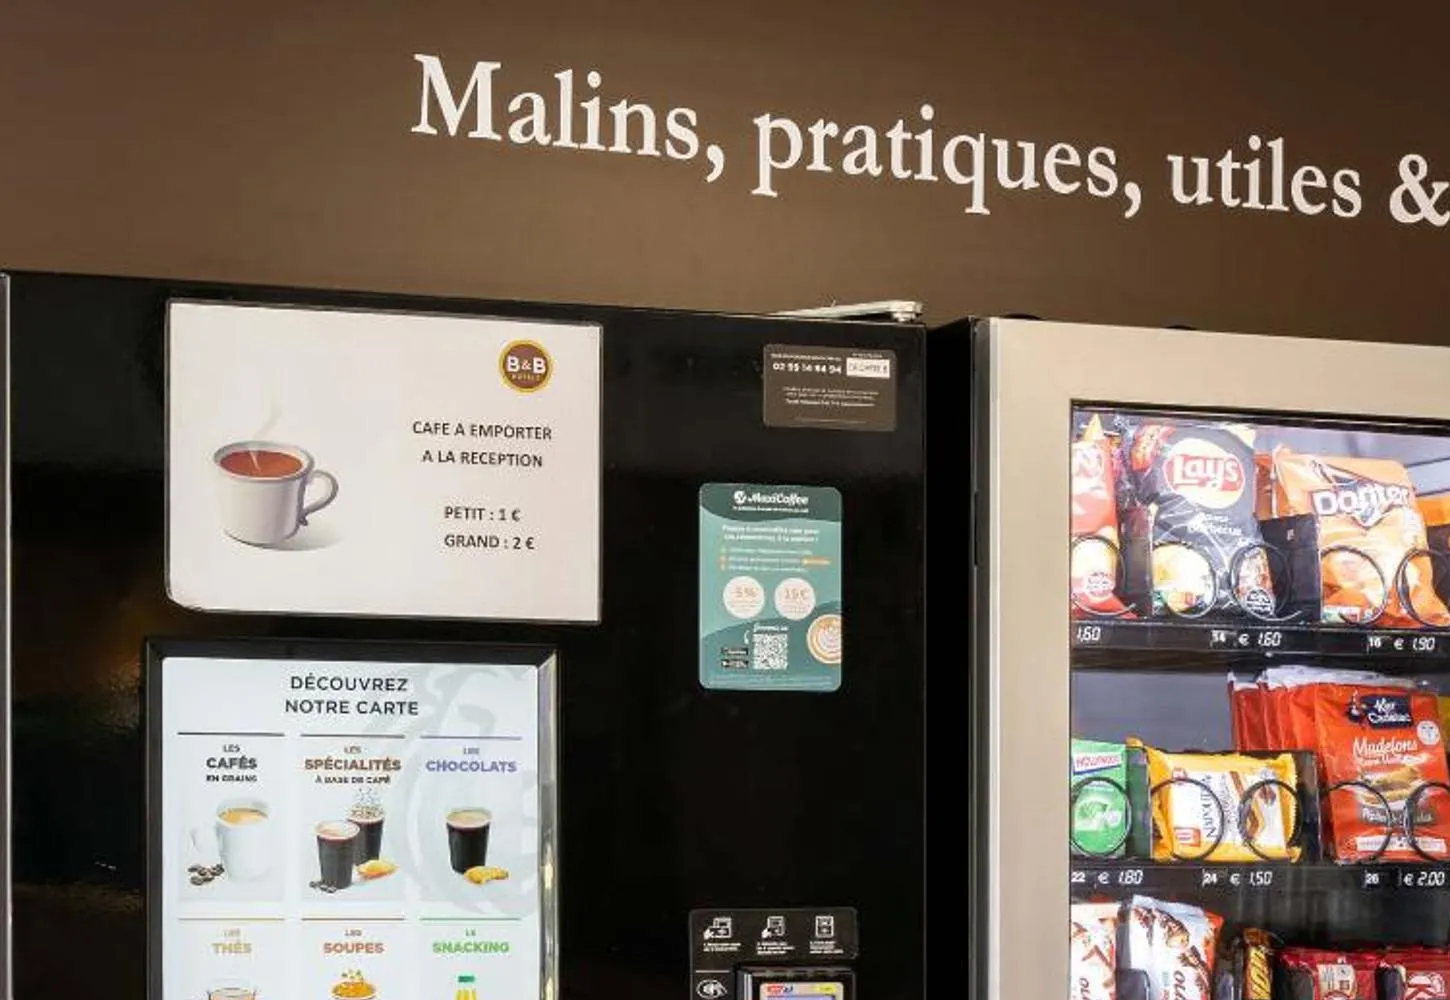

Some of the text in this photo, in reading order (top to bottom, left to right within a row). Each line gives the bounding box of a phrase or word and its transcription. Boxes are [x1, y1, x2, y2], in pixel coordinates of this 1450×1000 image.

[411, 54, 726, 183] Malins,
[751, 104, 1142, 218] pratiques,
[1167, 136, 1362, 218] utiles
[1389, 155, 1450, 226] &
[507, 355, 546, 374] B&B
[412, 420, 552, 440] CAFE A EMPORTER
[422, 449, 542, 467] A LA RECEPTION
[444, 505, 486, 521] PETIT
[498, 508, 507, 521] 1
[511, 508, 521, 522] €
[444, 533, 500, 548] GRAND
[512, 536, 521, 550] 2
[525, 536, 535, 550] €
[290, 673, 409, 692] DÉCOUVREZ
[285, 700, 419, 716] NOTRE CARTE
[206, 755, 258, 771] CAFÉS
[304, 755, 402, 772] SPÉCIALITÉS
[426, 759, 518, 773] CHOCOLATS
[1071, 872, 1086, 883] 22
[1203, 873, 1218, 884] 24
[323, 942, 385, 954] SOUPES
[432, 941, 510, 954] SNACKING
